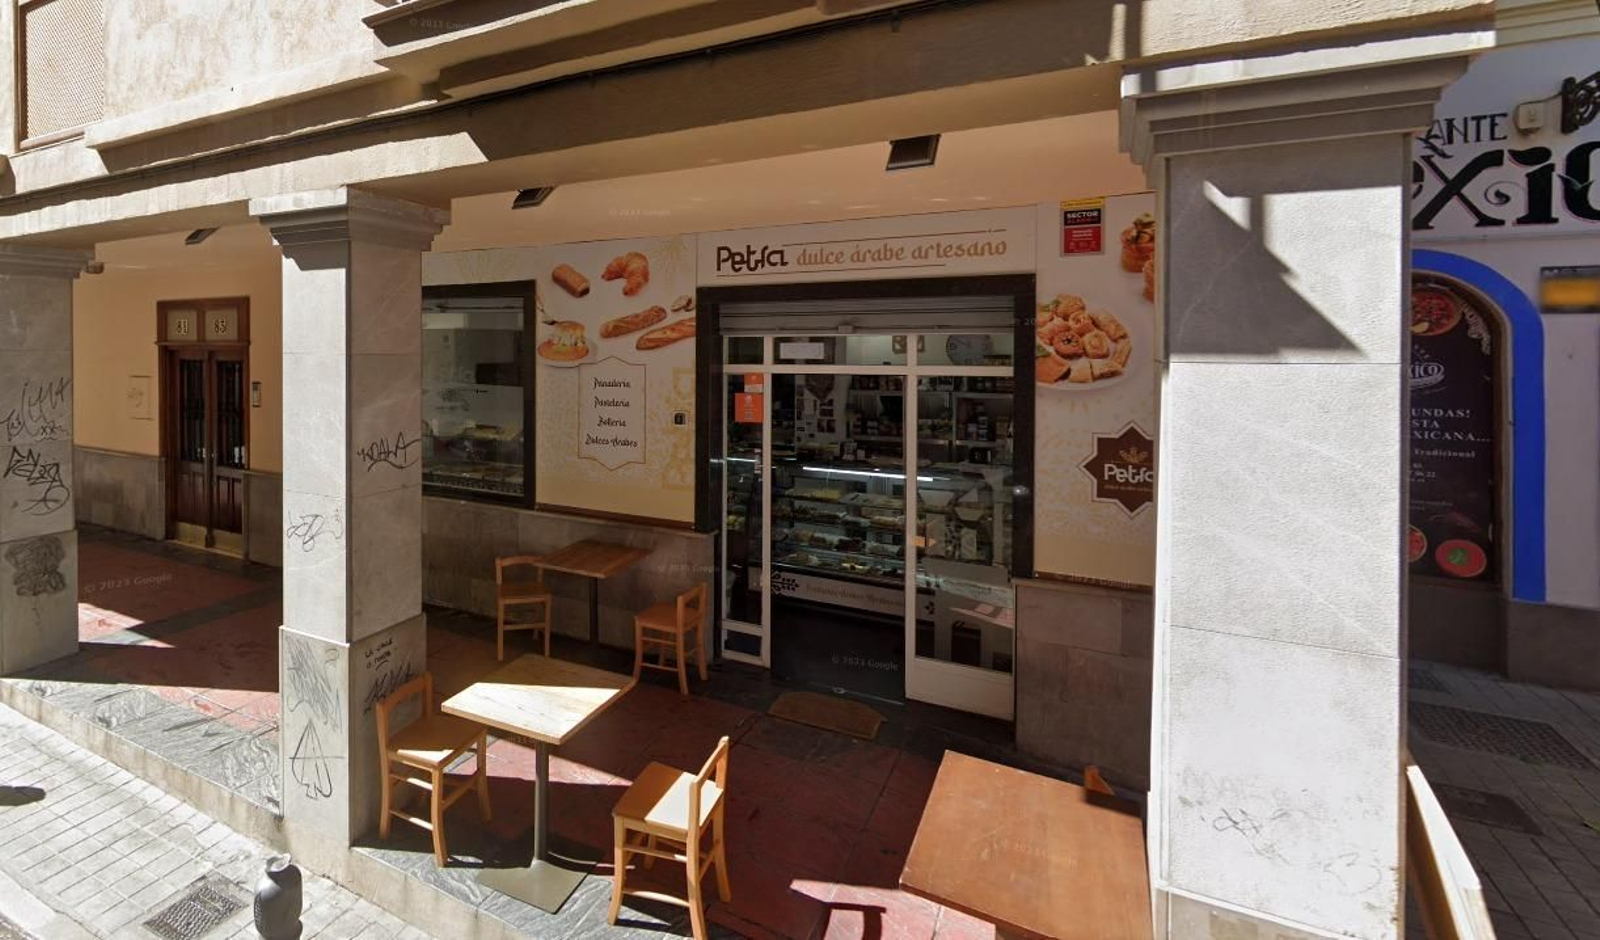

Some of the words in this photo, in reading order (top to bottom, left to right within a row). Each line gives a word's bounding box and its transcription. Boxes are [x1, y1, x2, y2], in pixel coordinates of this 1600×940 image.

[1066, 210, 1100, 219] SECTOR
[716, 245, 788, 273] Petra
[797, 247, 845, 267] dulce
[850, 243, 906, 263] árabe
[911, 239, 1007, 260] artesano
